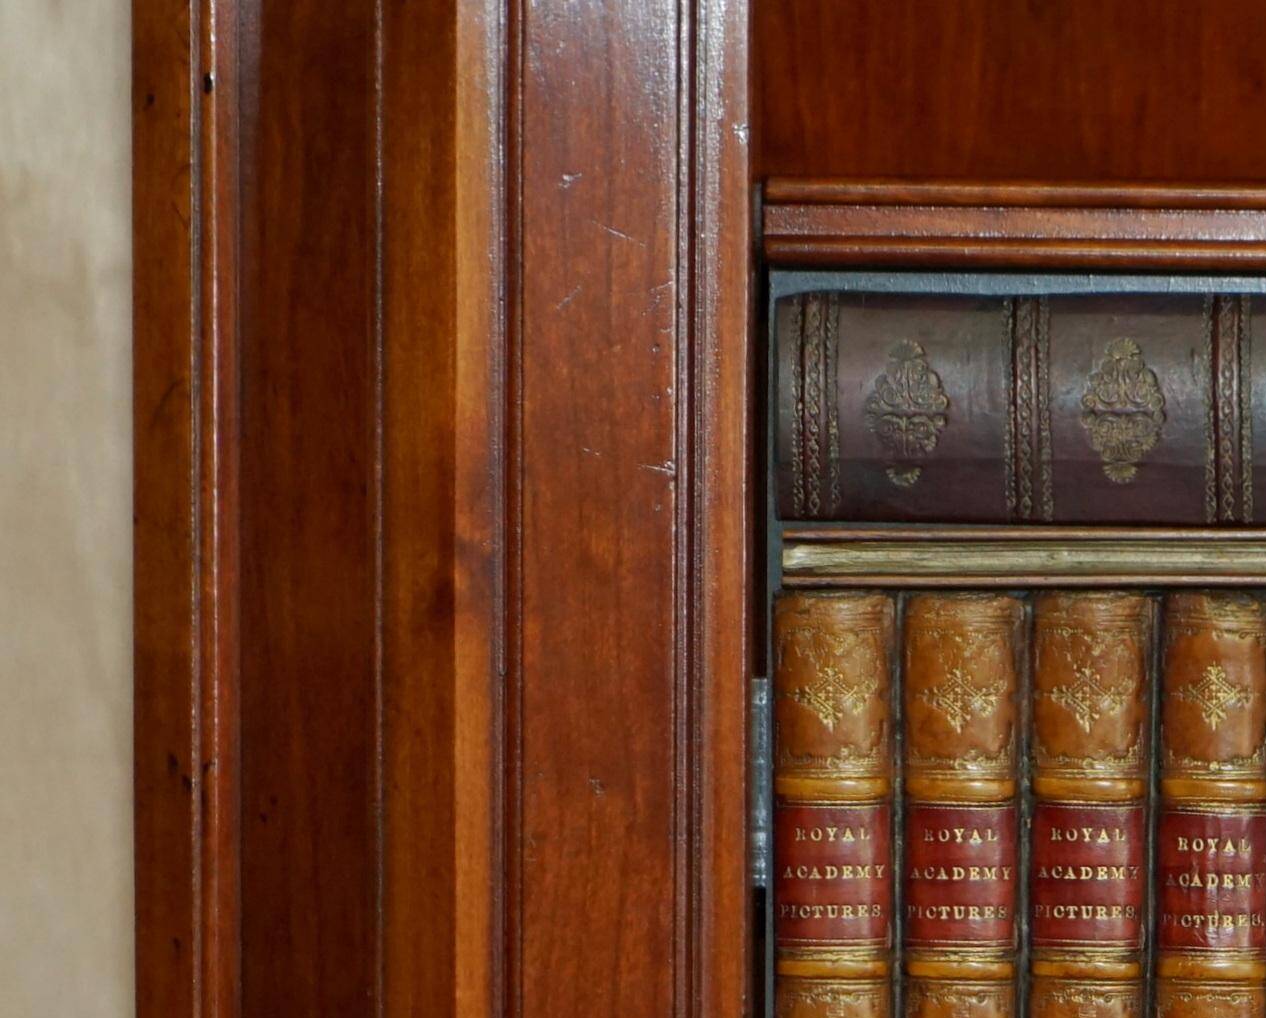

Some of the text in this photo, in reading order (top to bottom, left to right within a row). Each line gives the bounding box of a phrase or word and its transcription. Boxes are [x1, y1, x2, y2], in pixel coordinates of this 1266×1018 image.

[795, 827, 870, 842] ROYAL
[924, 827, 998, 843] ROYAL
[1051, 827, 1126, 842] ROYAL
[1177, 837, 1252, 853] ROYAL
[783, 864, 886, 880] ACADEMY
[910, 866, 1012, 881] ACADEMY
[1037, 865, 1140, 880] ACADEMY
[1165, 873, 1265, 888] ACADEMY
